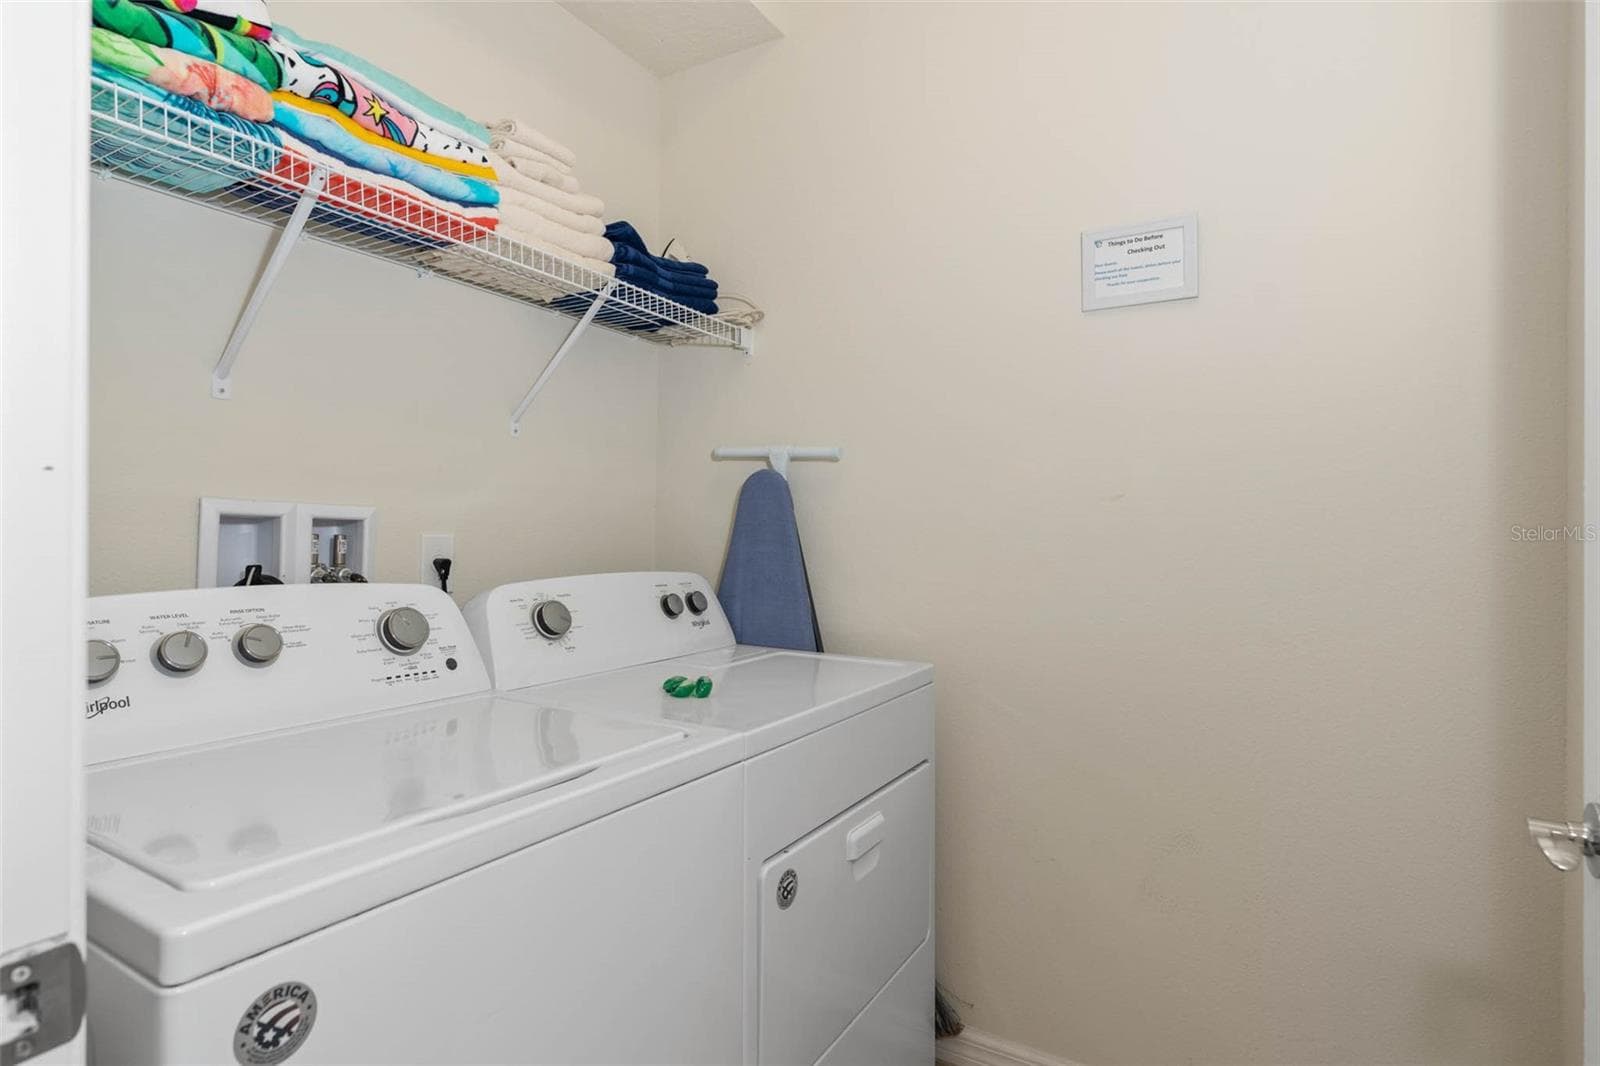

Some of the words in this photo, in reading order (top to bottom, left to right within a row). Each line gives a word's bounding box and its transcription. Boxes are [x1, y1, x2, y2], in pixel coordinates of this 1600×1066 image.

[1108, 240, 1126, 248] Things
[1144, 234, 1163, 242] Before
[1127, 245, 1154, 255] Checking
[239, 984, 310, 1036] AMERICA
